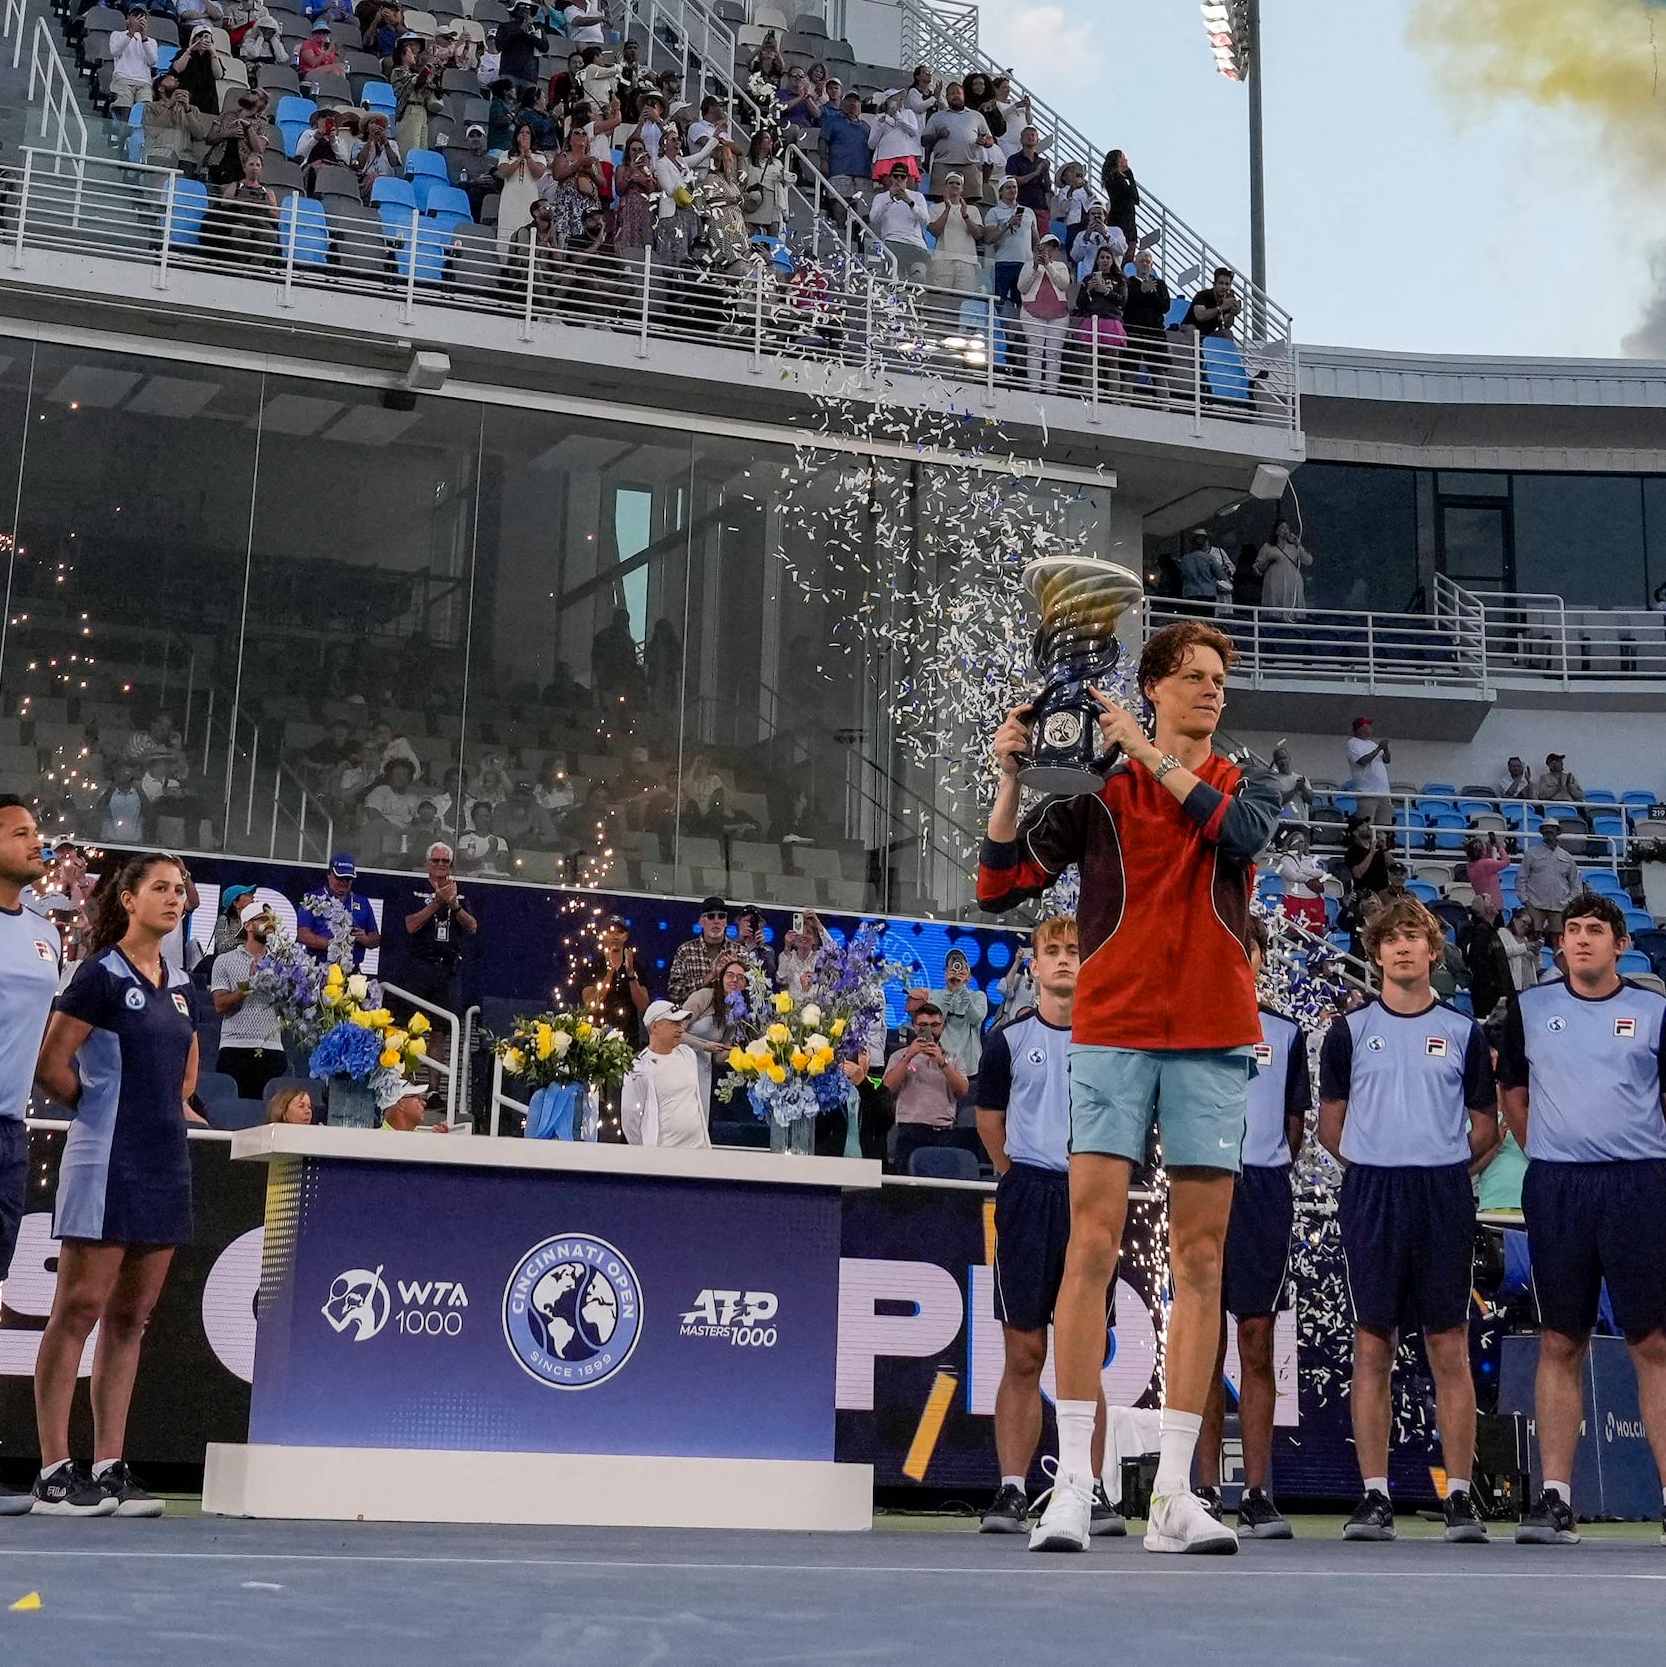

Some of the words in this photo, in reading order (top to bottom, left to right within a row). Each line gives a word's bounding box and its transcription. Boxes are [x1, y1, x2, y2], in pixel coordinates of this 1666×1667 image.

[1651, 809, 1666, 818] 219
[397, 1280, 469, 1307] WTA
[511, 1242, 605, 1315] CINCINNATI
[606, 1260, 635, 1319] OPEN
[679, 1289, 779, 1326] ATP
[394, 1309, 464, 1336] 1000
[679, 1324, 732, 1338] MASTERS
[730, 1326, 778, 1348] 1000
[529, 1350, 573, 1377] SINCE
[578, 1353, 613, 1377] 1899
[1615, 1419, 1647, 1439] HOLCI
[46, 1485, 66, 1497] FILA
